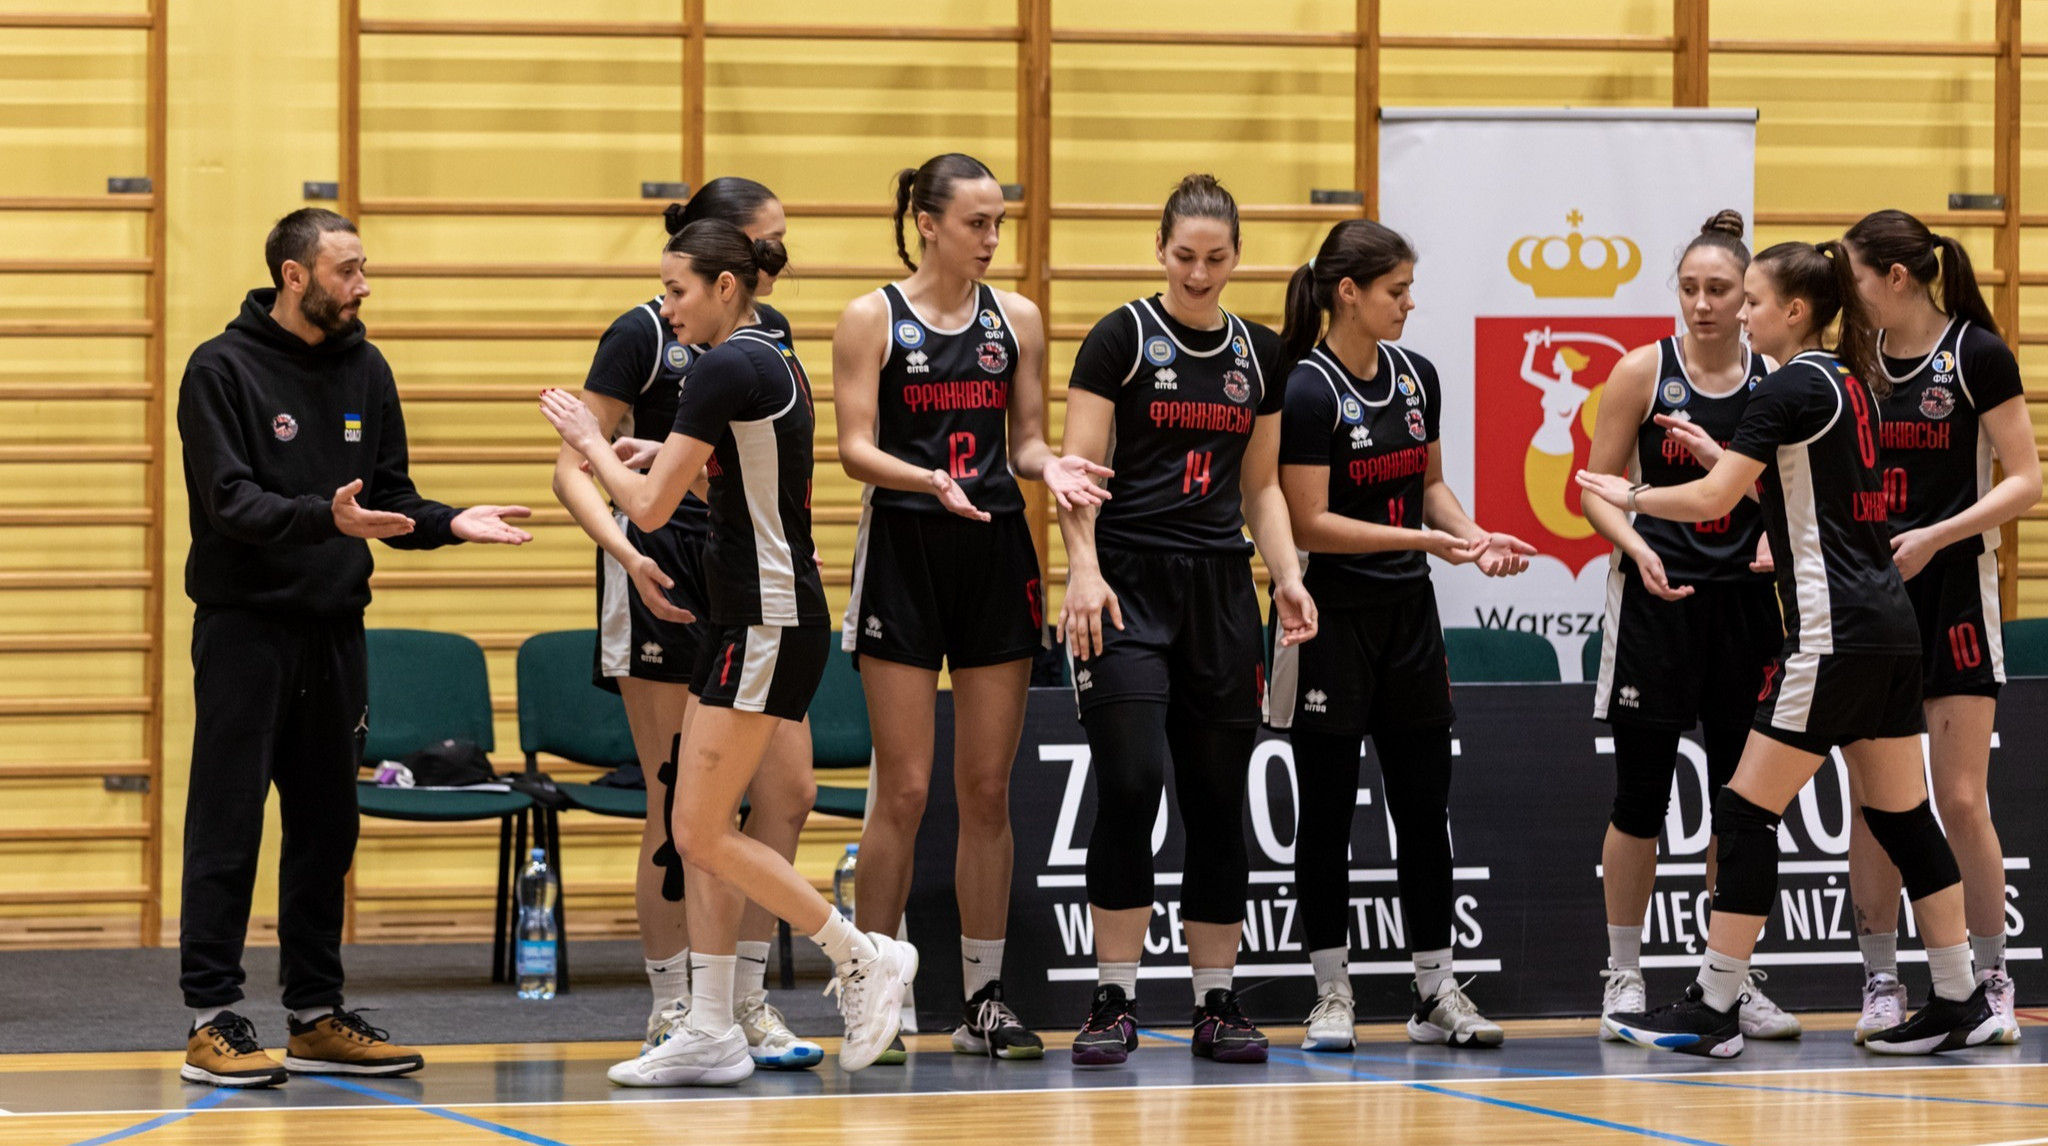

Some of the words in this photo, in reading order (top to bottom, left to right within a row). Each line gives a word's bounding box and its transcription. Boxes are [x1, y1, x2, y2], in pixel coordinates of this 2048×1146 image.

[985, 330, 1004, 340] ФБУ
[1234, 358, 1250, 370] ФБУ
[1933, 373, 1954, 383] ФБУ
[1149, 400, 1252, 434] ФРАНКІВСЬК
[1845, 376, 1876, 469] 8
[1879, 421, 1951, 450] НКІВСЬК
[949, 432, 978, 479] 12
[1182, 449, 1213, 496] 14
[1348, 445, 1428, 486] ФРАНКІВСЬ
[1883, 467, 1907, 513] 10
[1948, 622, 1982, 672] 10
[1053, 899, 1191, 956] WCE
[1237, 885, 1303, 953] NIŻ
[1780, 875, 1852, 941] NIŻ
